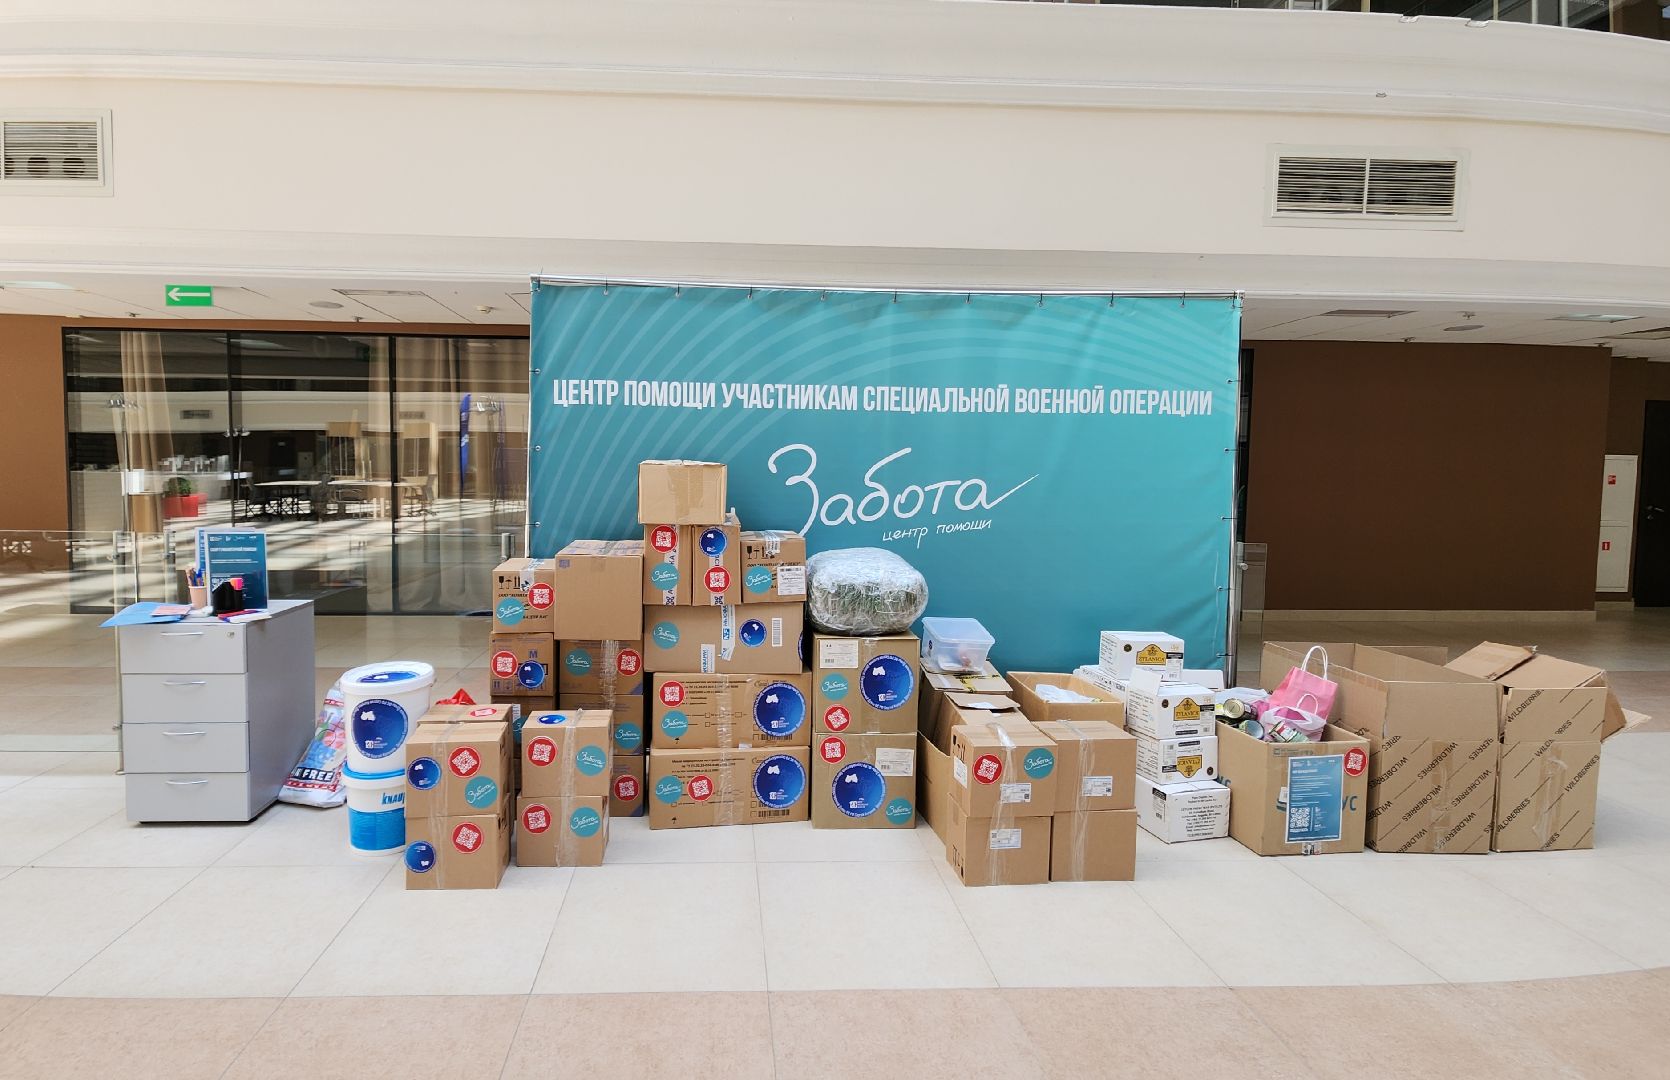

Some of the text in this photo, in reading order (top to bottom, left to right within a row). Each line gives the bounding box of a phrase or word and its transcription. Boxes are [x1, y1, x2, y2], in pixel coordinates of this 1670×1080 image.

[553, 380, 1213, 417] ЦЕНТР ПОМОЩИ УЧАСТНИКАМ СПЕЦИАЛЬНОЙ ВОЕННОЙ ОПЕРАЦИИ
[768, 443, 1039, 537] Забота
[882, 519, 992, 549] центр помощи
[302, 769, 334, 781] FREE
[1417, 742, 1458, 780] WILDBERRIES
[1564, 754, 1600, 792] WILDBERRIES
[1401, 784, 1443, 822] WILDBERRIES
[1451, 769, 1492, 808] WILDBERRIES
